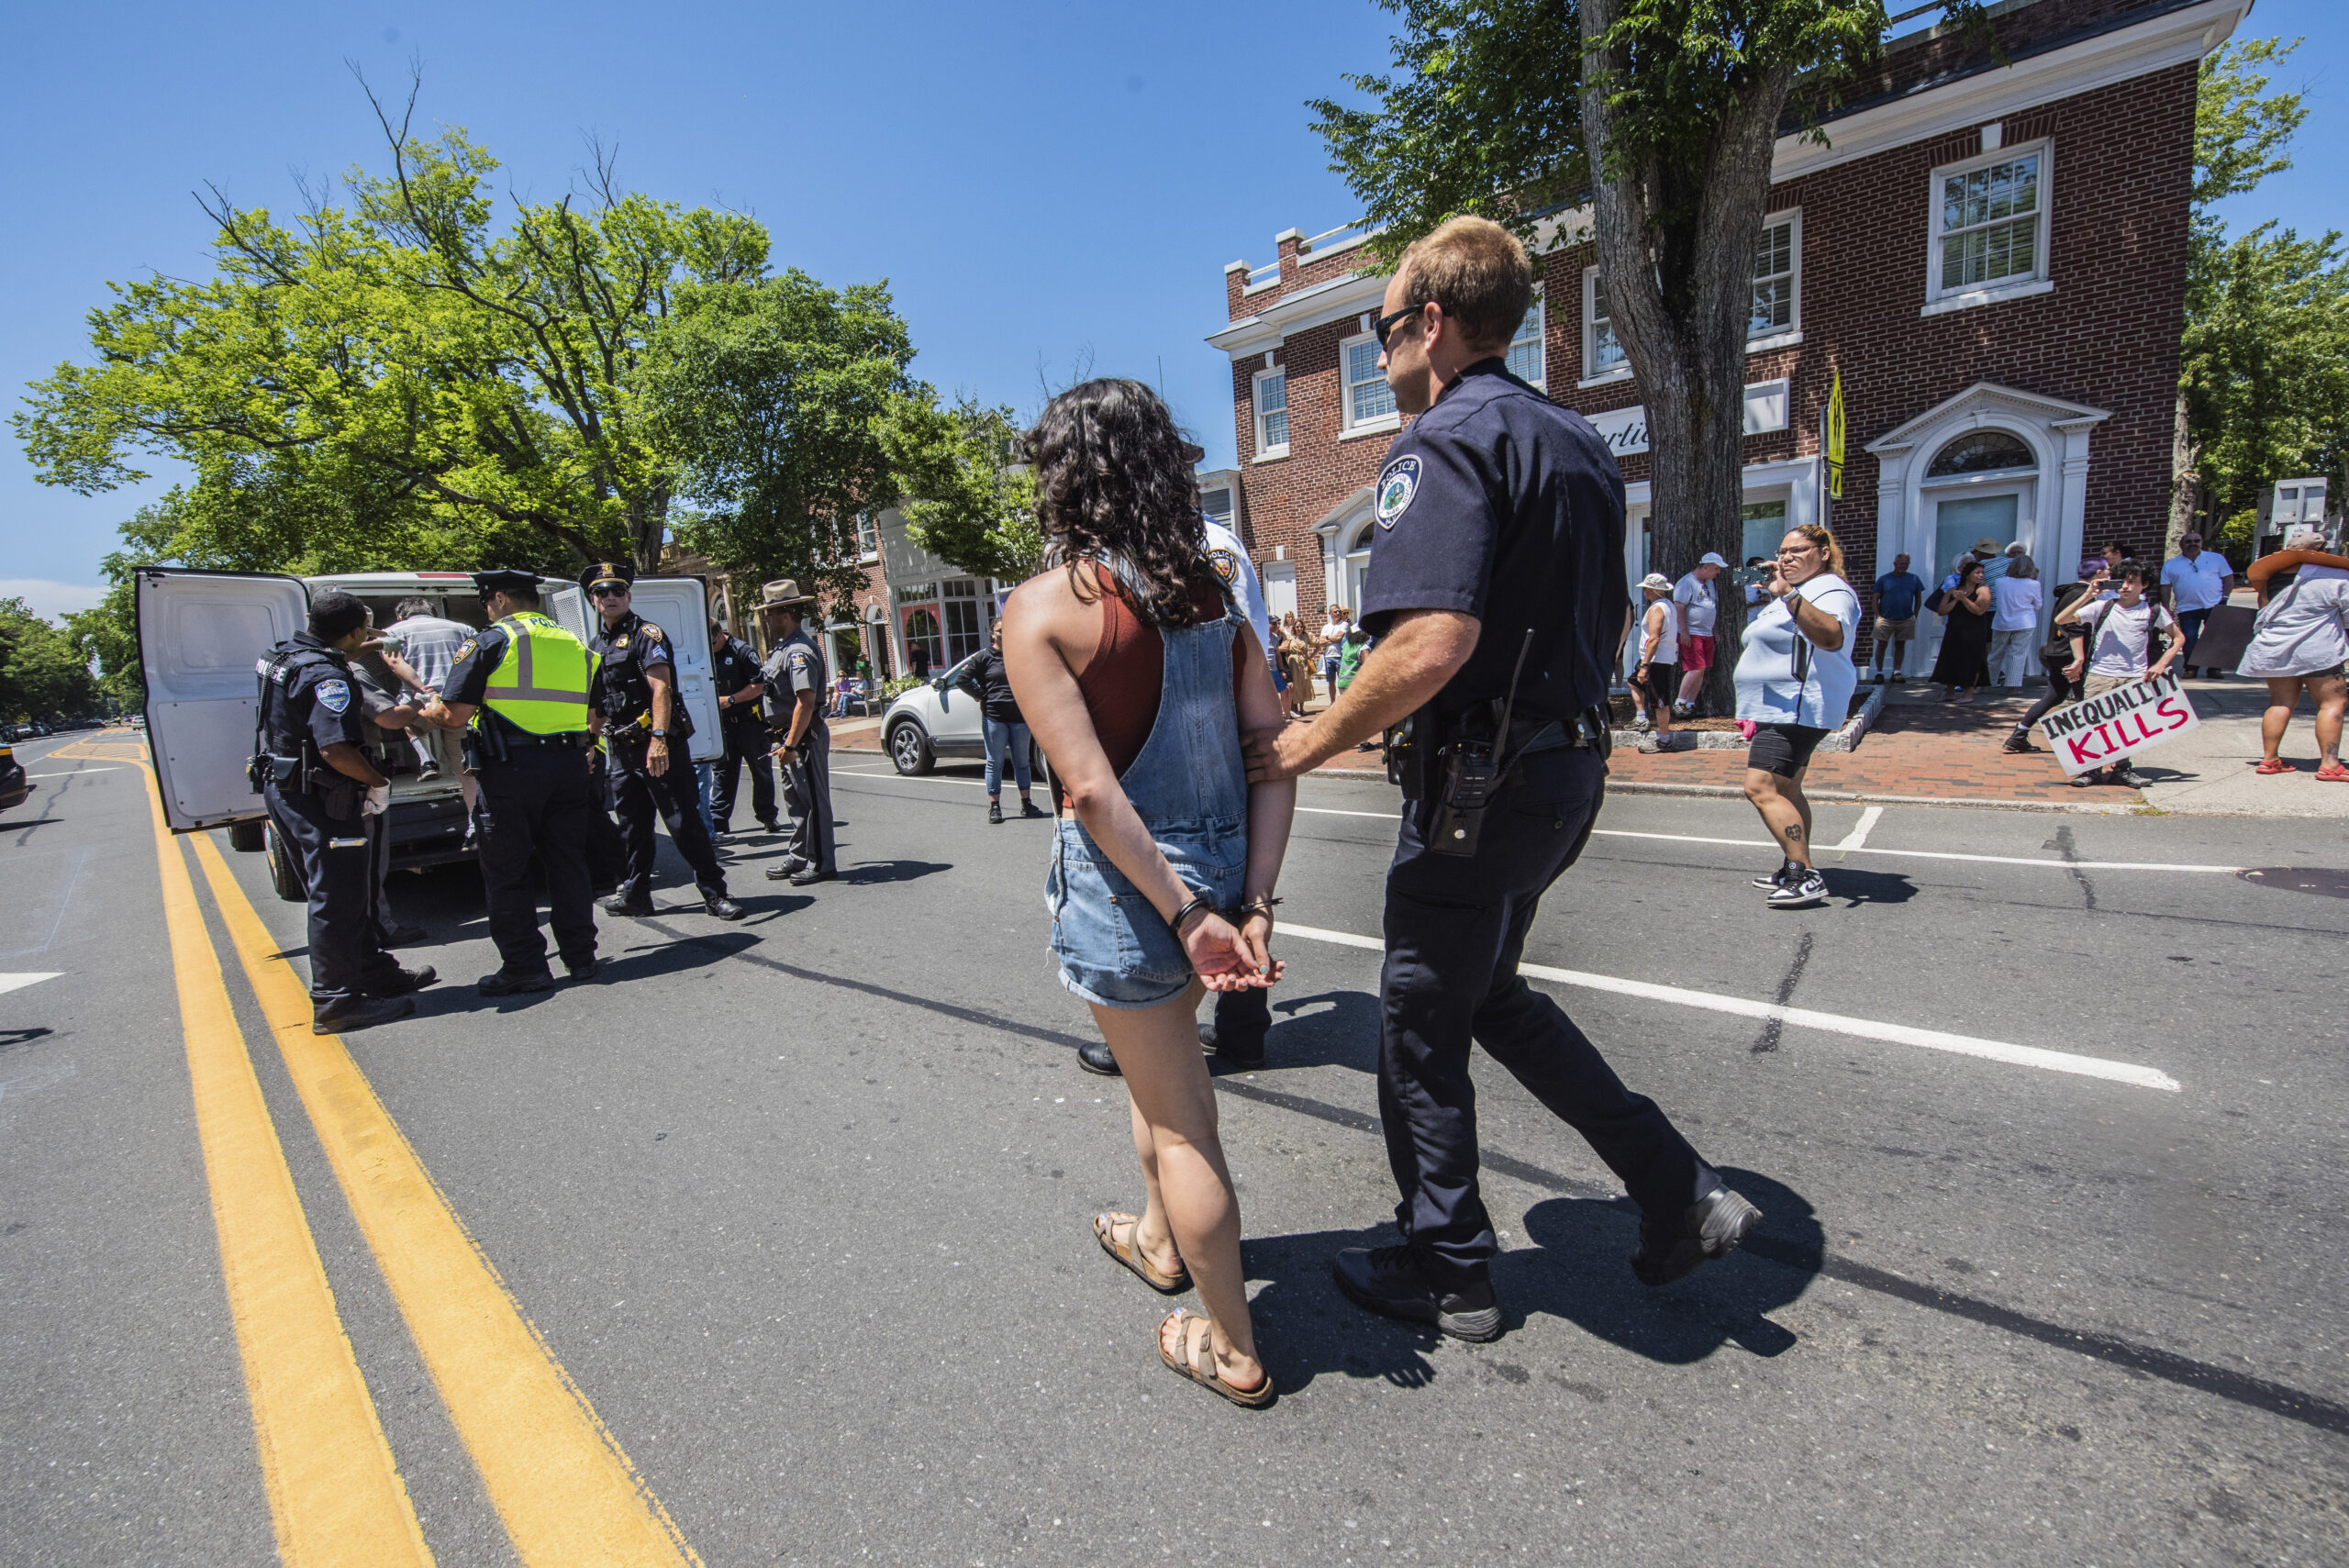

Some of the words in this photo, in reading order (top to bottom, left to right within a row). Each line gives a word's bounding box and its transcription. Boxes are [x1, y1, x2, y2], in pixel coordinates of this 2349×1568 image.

[1380, 461, 1417, 490] POLICE
[2042, 668, 2178, 740] INEQUALITY
[2067, 697, 2188, 764] KILLS
